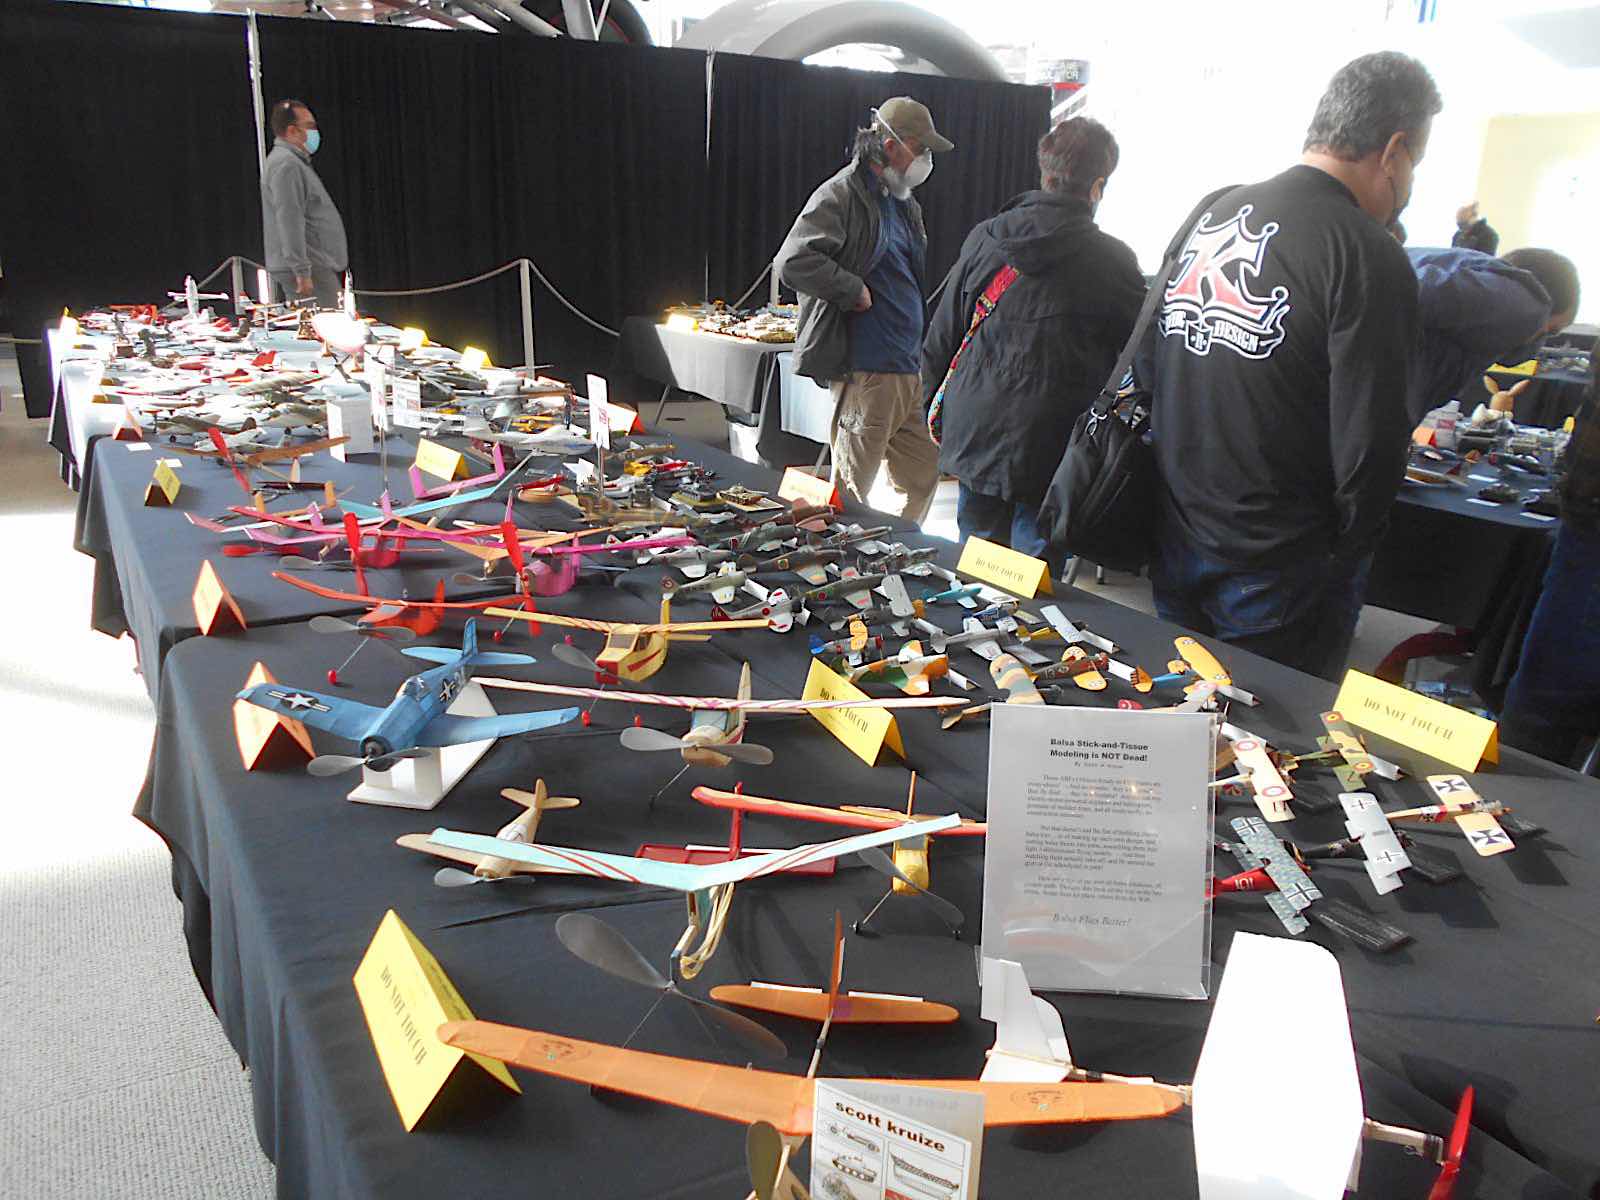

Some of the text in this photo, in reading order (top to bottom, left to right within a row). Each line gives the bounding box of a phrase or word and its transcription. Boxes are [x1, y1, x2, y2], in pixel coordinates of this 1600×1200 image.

[1214, 320, 1260, 352] DESIGN
[1000, 567, 1024, 582] TOUCH
[1364, 697, 1454, 741] DO NOT TOUCH
[1050, 738, 1074, 747] Balsa
[1050, 749, 1089, 760] Modeling
[1101, 752, 1120, 760] NOT
[1123, 754, 1148, 762] Dead!
[380, 965, 428, 1066] DO NOT TOUCH
[835, 1102, 946, 1153] scott kruize
